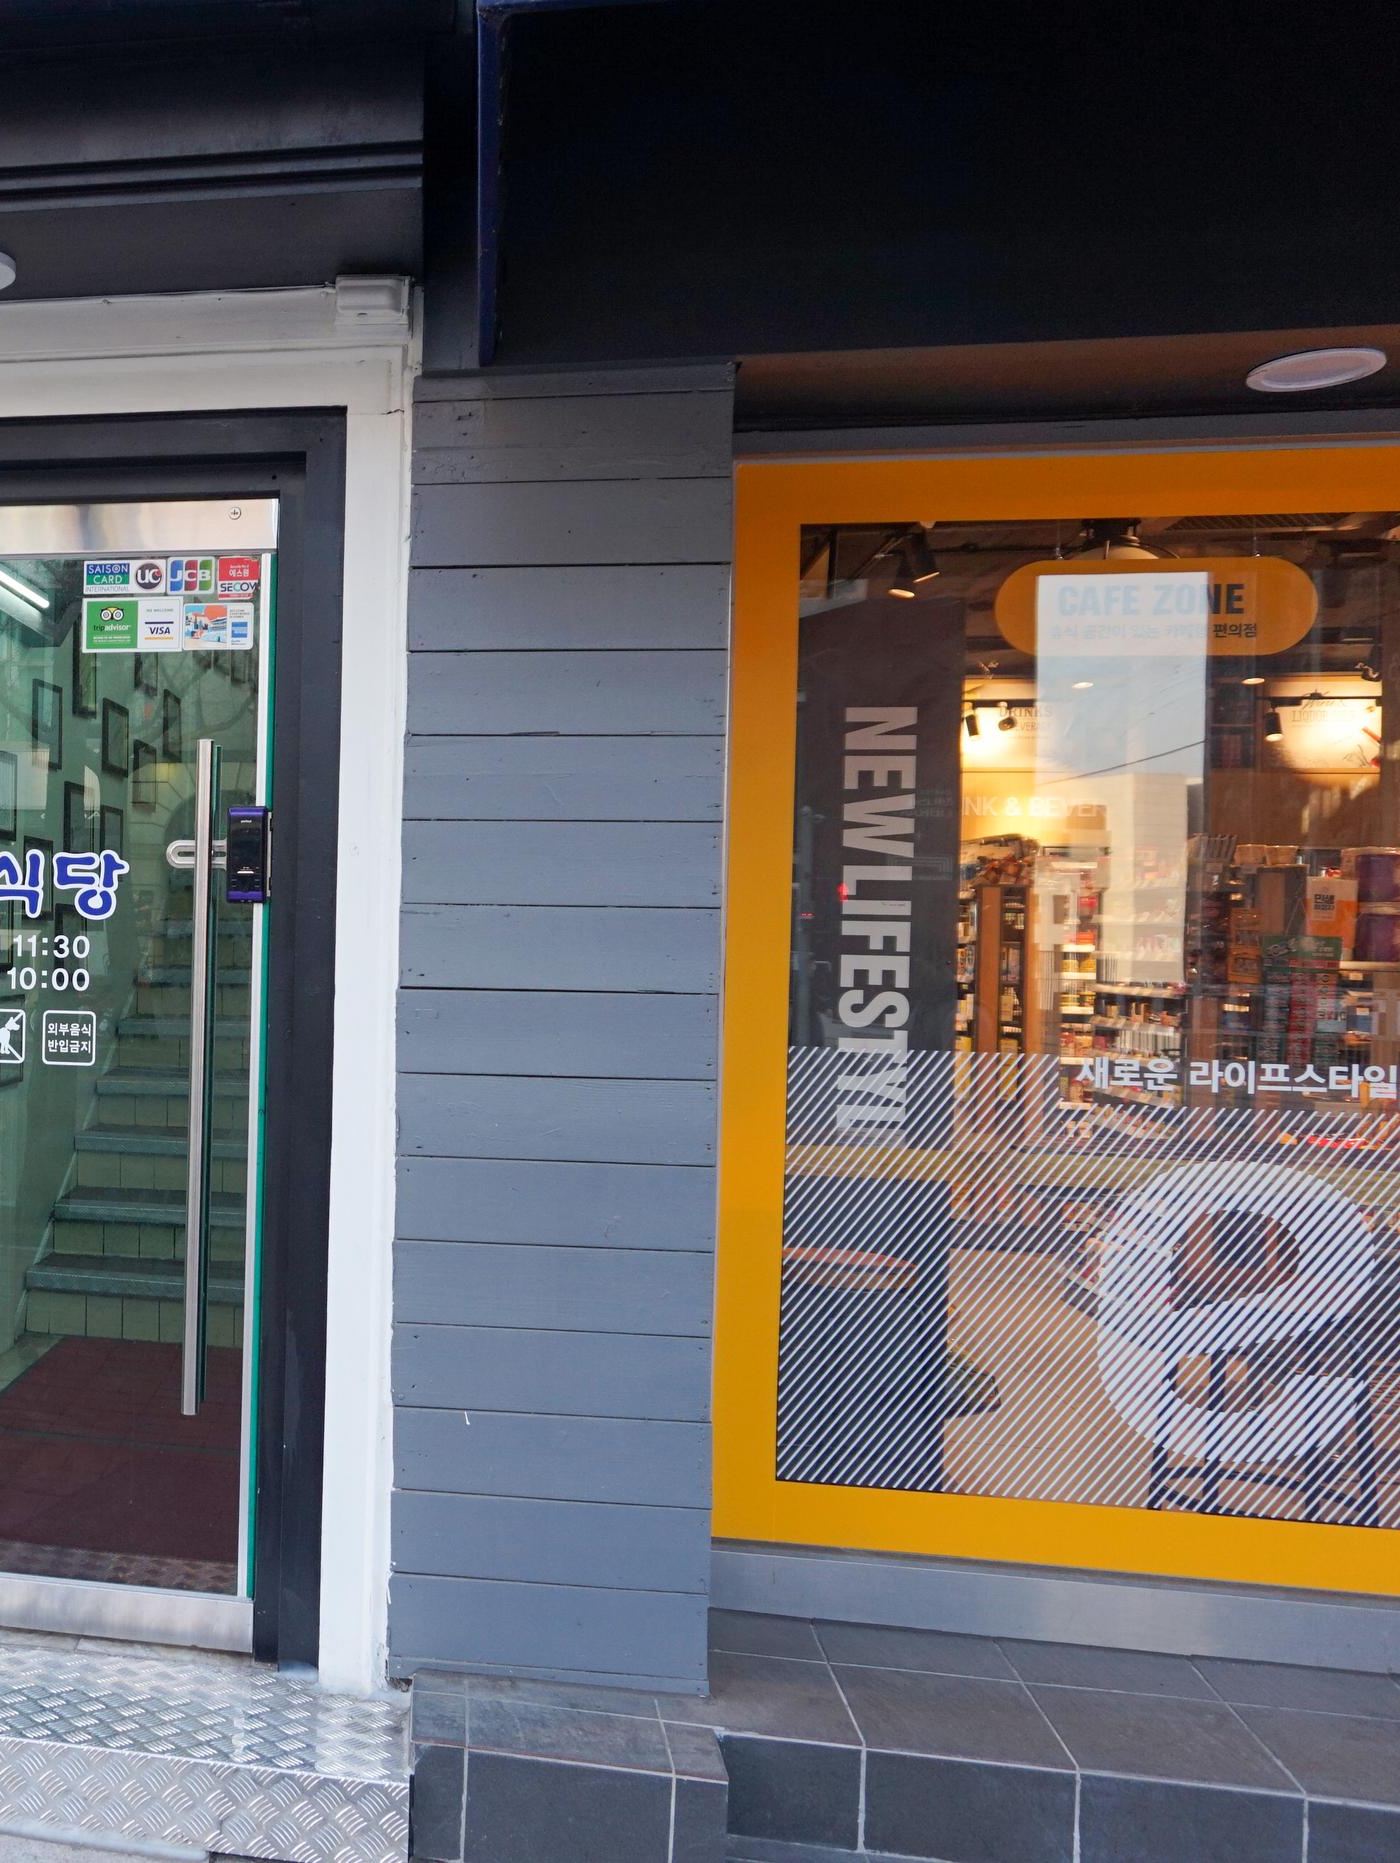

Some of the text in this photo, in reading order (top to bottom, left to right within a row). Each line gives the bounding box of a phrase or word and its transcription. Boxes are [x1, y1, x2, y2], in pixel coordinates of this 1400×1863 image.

[88, 564, 128, 574] SAISON
[93, 575, 122, 584] CARD
[1058, 583, 1245, 617] CAFE ZONE
[93, 624, 129, 632] tripadvisor
[149, 627, 171, 635] VISA
[1212, 623, 1257, 638] 편의점
[14, 935, 90, 959] 11:30
[7, 967, 90, 991] 10:00
[47, 1023, 91, 1037] 외부음식
[47, 1040, 91, 1054] 반입금지
[1076, 1056, 1398, 1099] 새로운 라이프스타일
